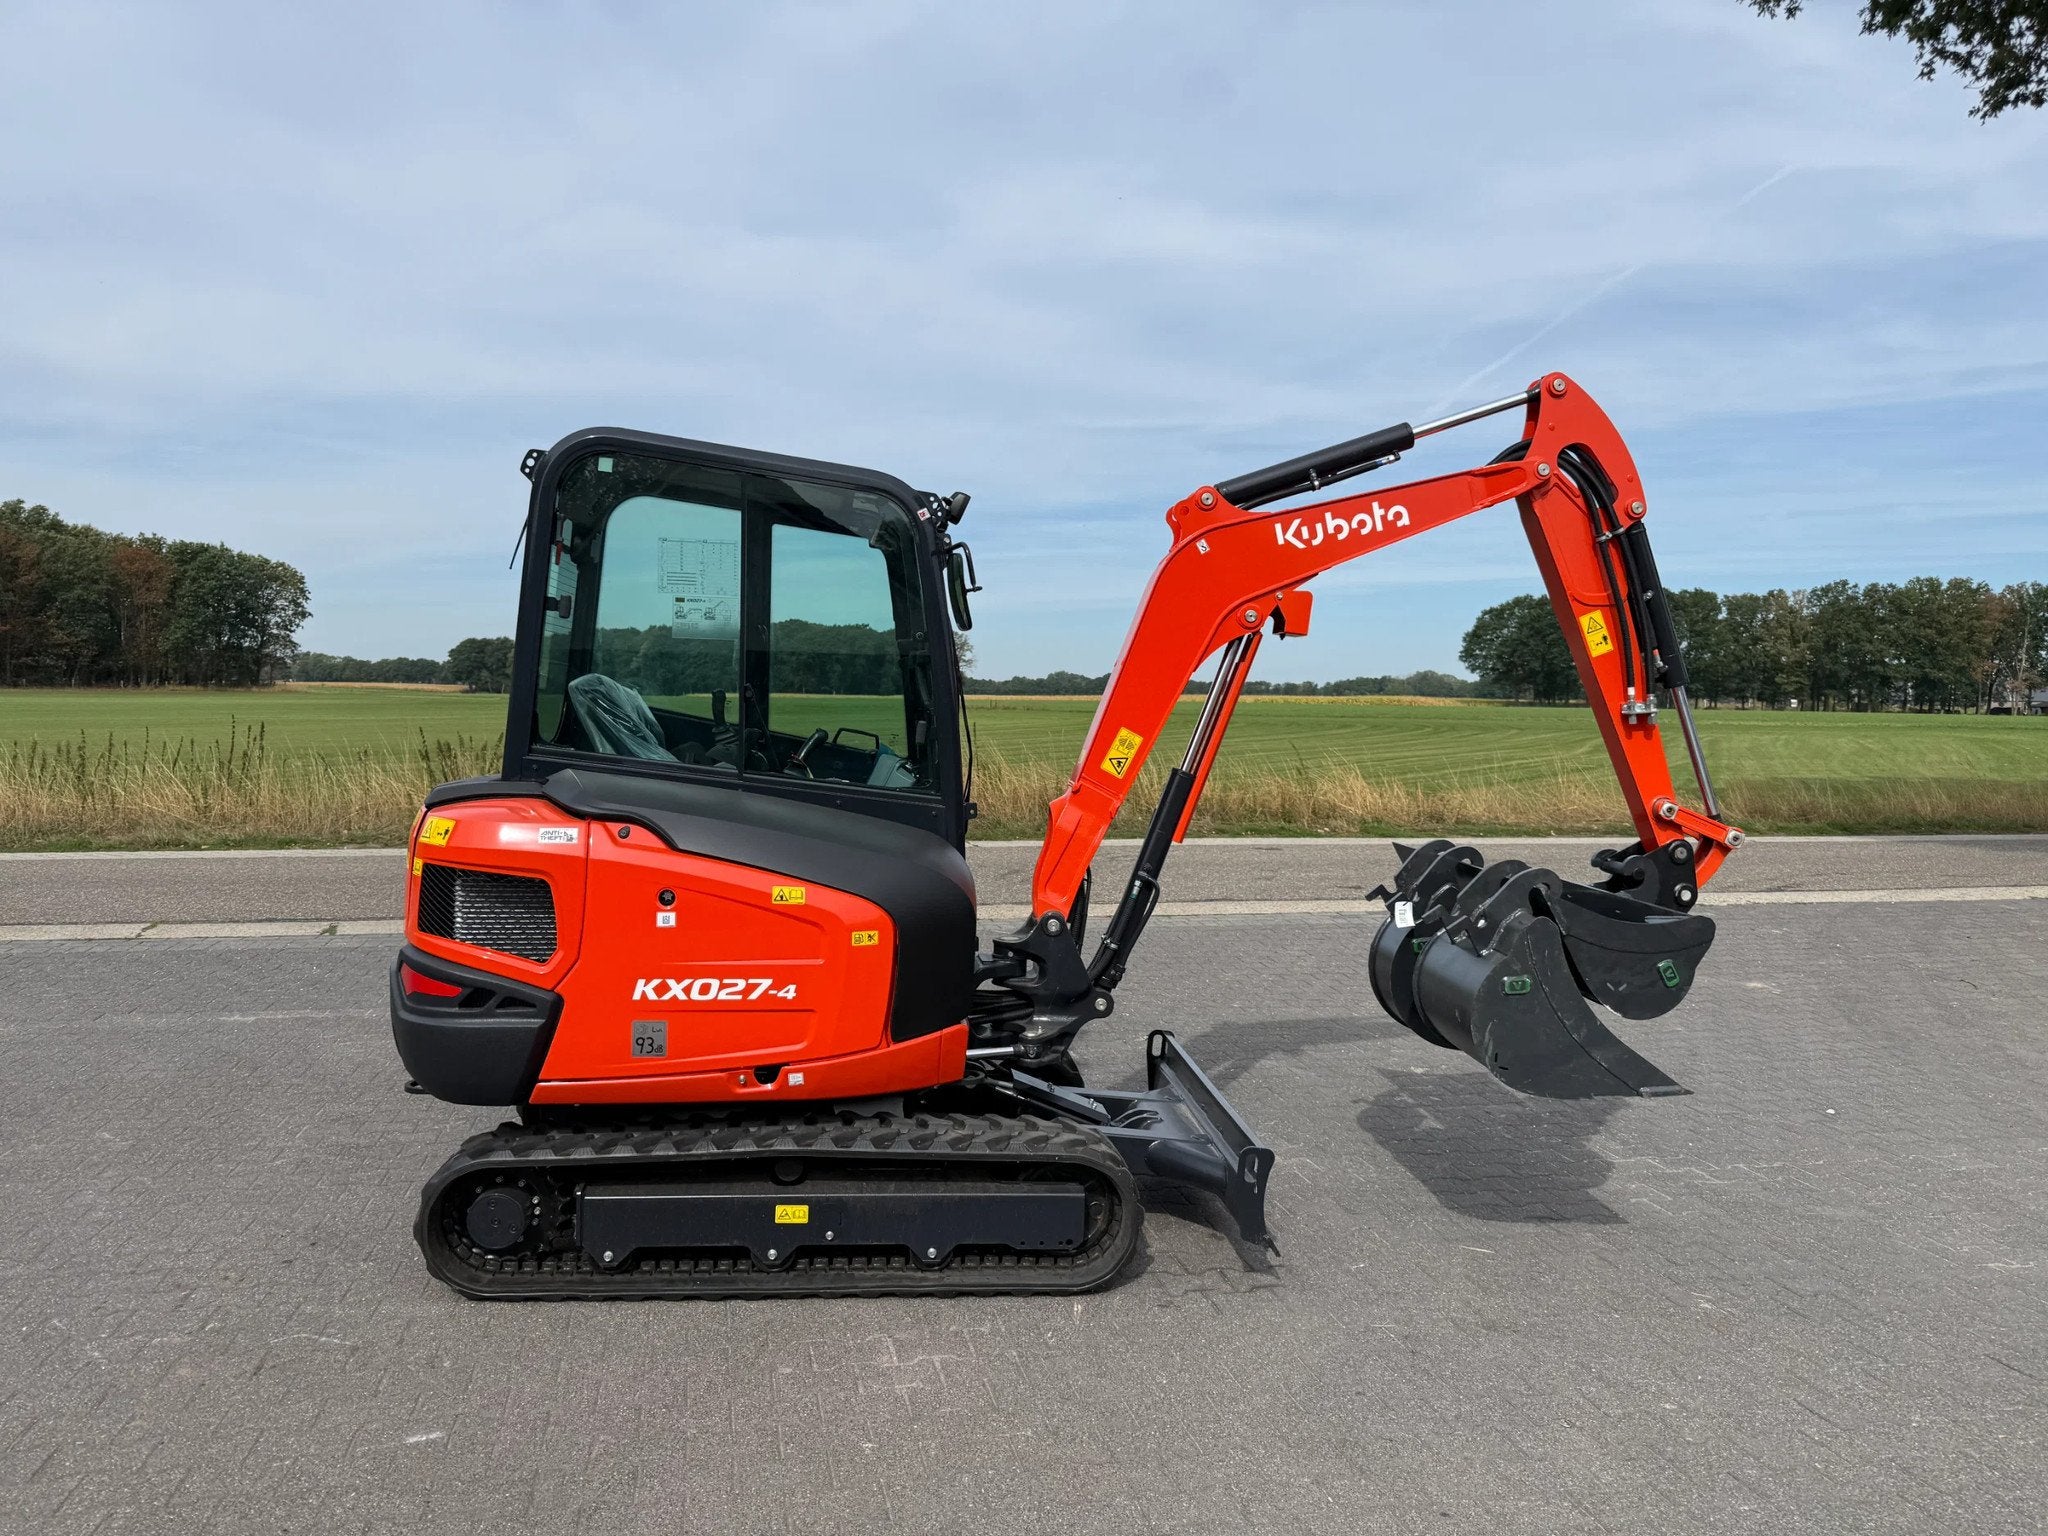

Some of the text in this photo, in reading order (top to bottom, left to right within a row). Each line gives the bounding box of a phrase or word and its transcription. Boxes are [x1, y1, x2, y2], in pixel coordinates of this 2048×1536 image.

[1274, 501, 1411, 549] Kubota
[632, 978, 797, 1001] KX027-4
[635, 1036, 655, 1055] 93
